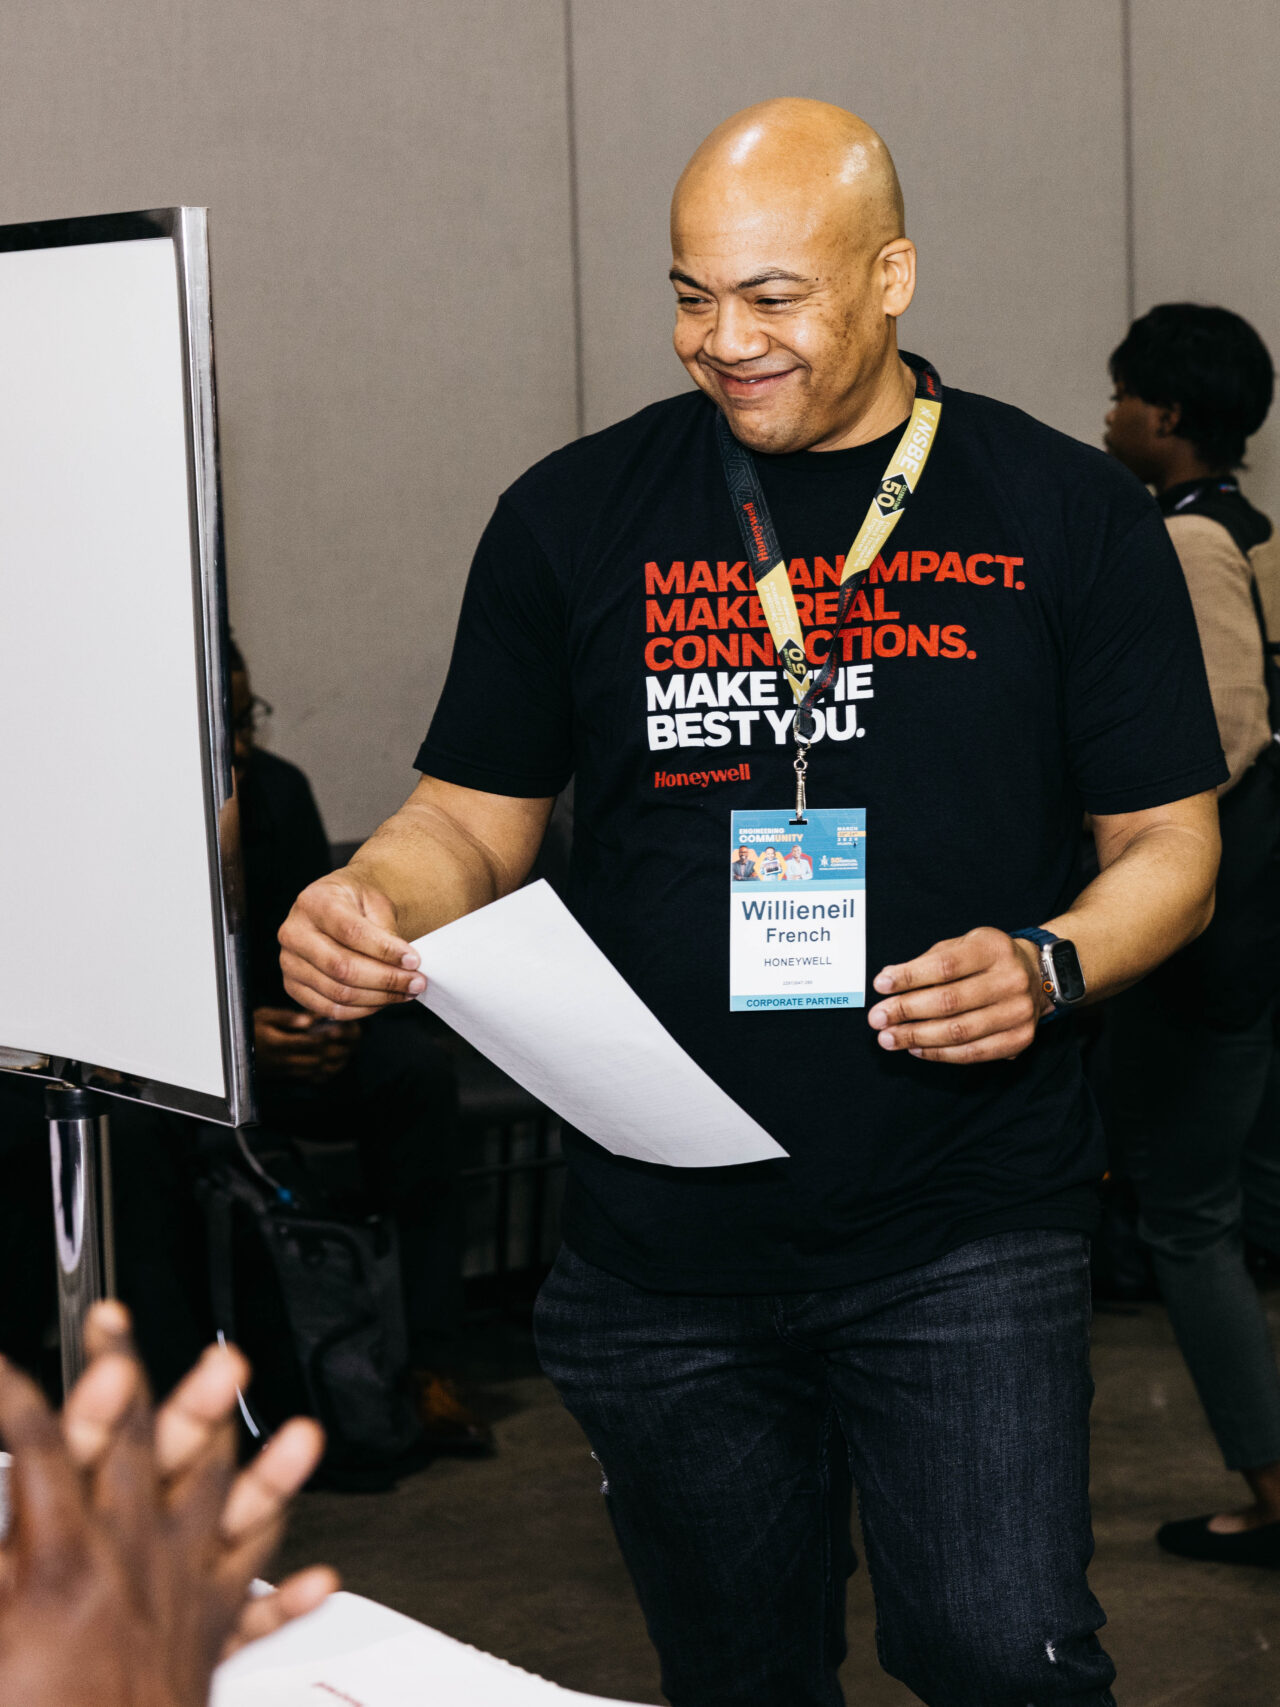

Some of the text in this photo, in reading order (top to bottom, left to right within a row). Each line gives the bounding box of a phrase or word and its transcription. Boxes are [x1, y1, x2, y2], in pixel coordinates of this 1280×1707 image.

[899, 418, 933, 474] NSBE
[876, 479, 902, 508] 50
[742, 502, 769, 562] Honeywell
[644, 550, 1026, 595] MAK AN MPACT.
[645, 595, 768, 633] MAKE
[793, 589, 900, 627] REAL
[644, 624, 977, 672] CONNCTIONS.
[788, 647, 807, 675] 50
[645, 671, 779, 712] MAKE
[647, 705, 866, 751] BEST YOU.
[653, 763, 751, 789] Honeywell
[738, 833, 804, 843] COMMUNITY
[741, 898, 855, 921] Willieneil
[766, 926, 831, 943] French
[764, 956, 833, 967] HONEYWELL
[746, 996, 849, 1008] CORPORATE PARTNER
